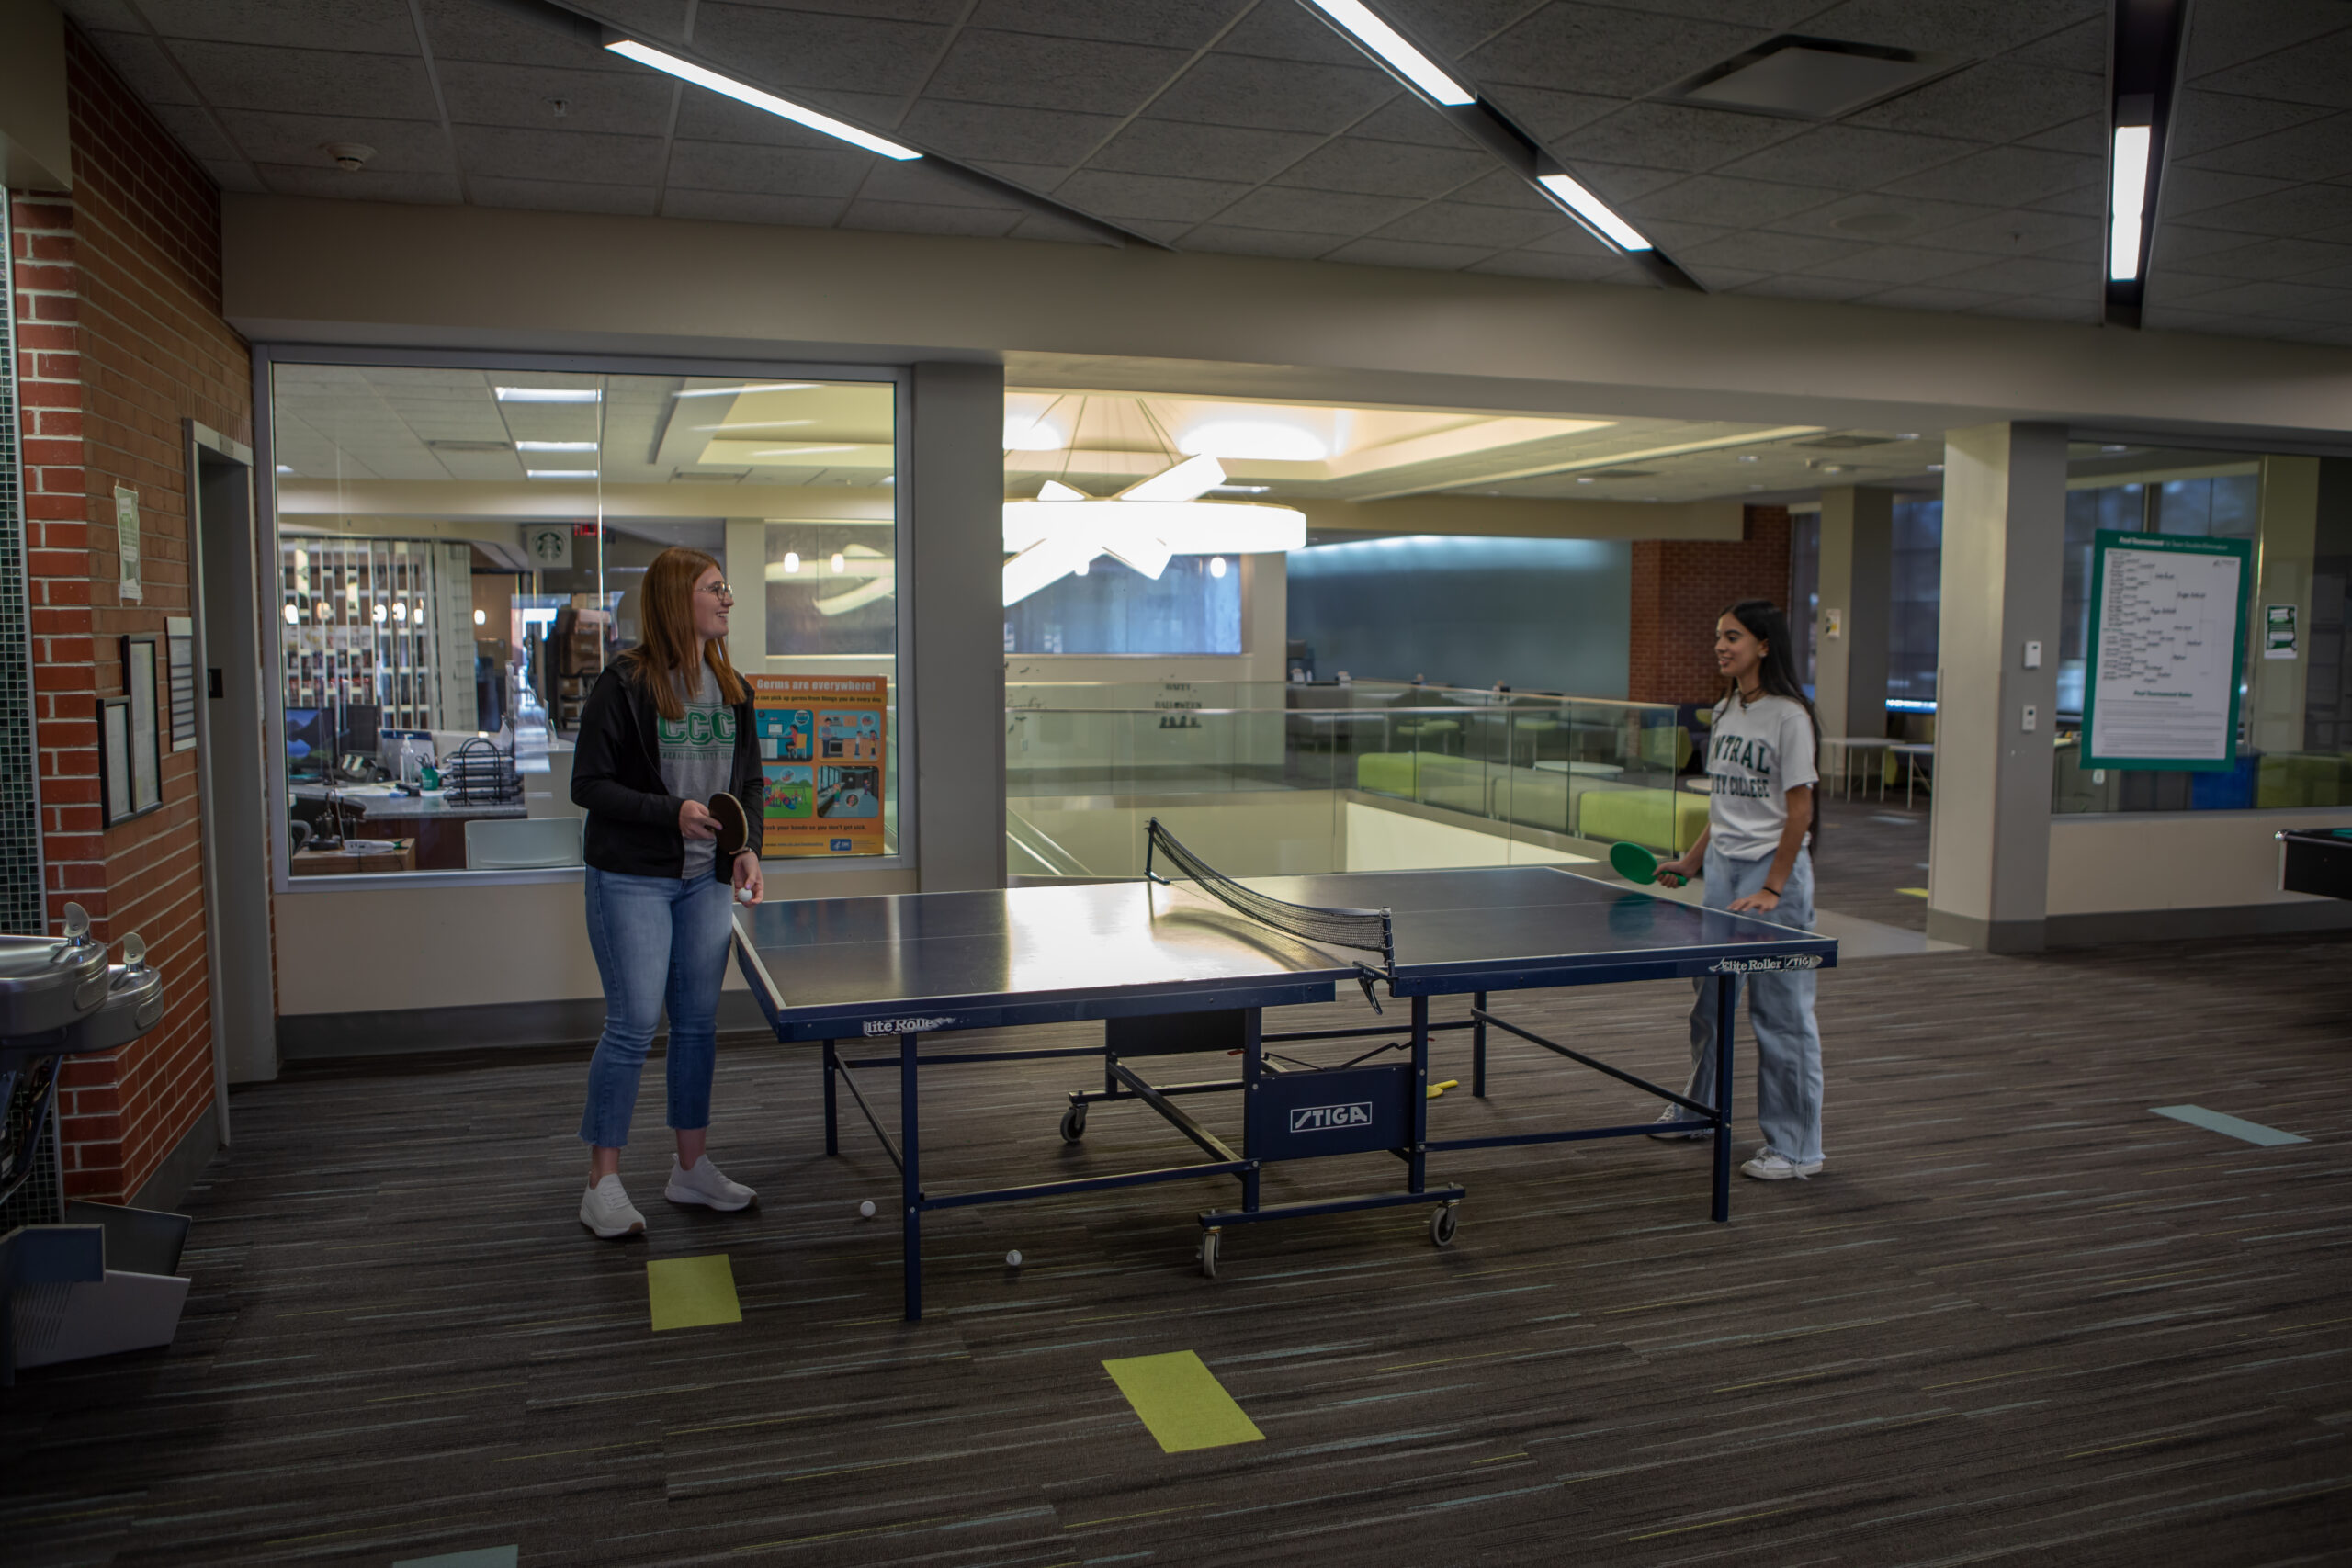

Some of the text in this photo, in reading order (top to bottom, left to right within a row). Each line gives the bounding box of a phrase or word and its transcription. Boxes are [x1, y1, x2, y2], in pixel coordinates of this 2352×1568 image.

[757, 679, 876, 692] Germs are everywhere!
[1730, 776, 1770, 798] COLLEGE
[1748, 958, 1781, 971] Roller
[1786, 956, 1810, 966] STIG
[895, 1018, 933, 1030] Rolle
[1295, 1106, 1368, 1129] STIGA
